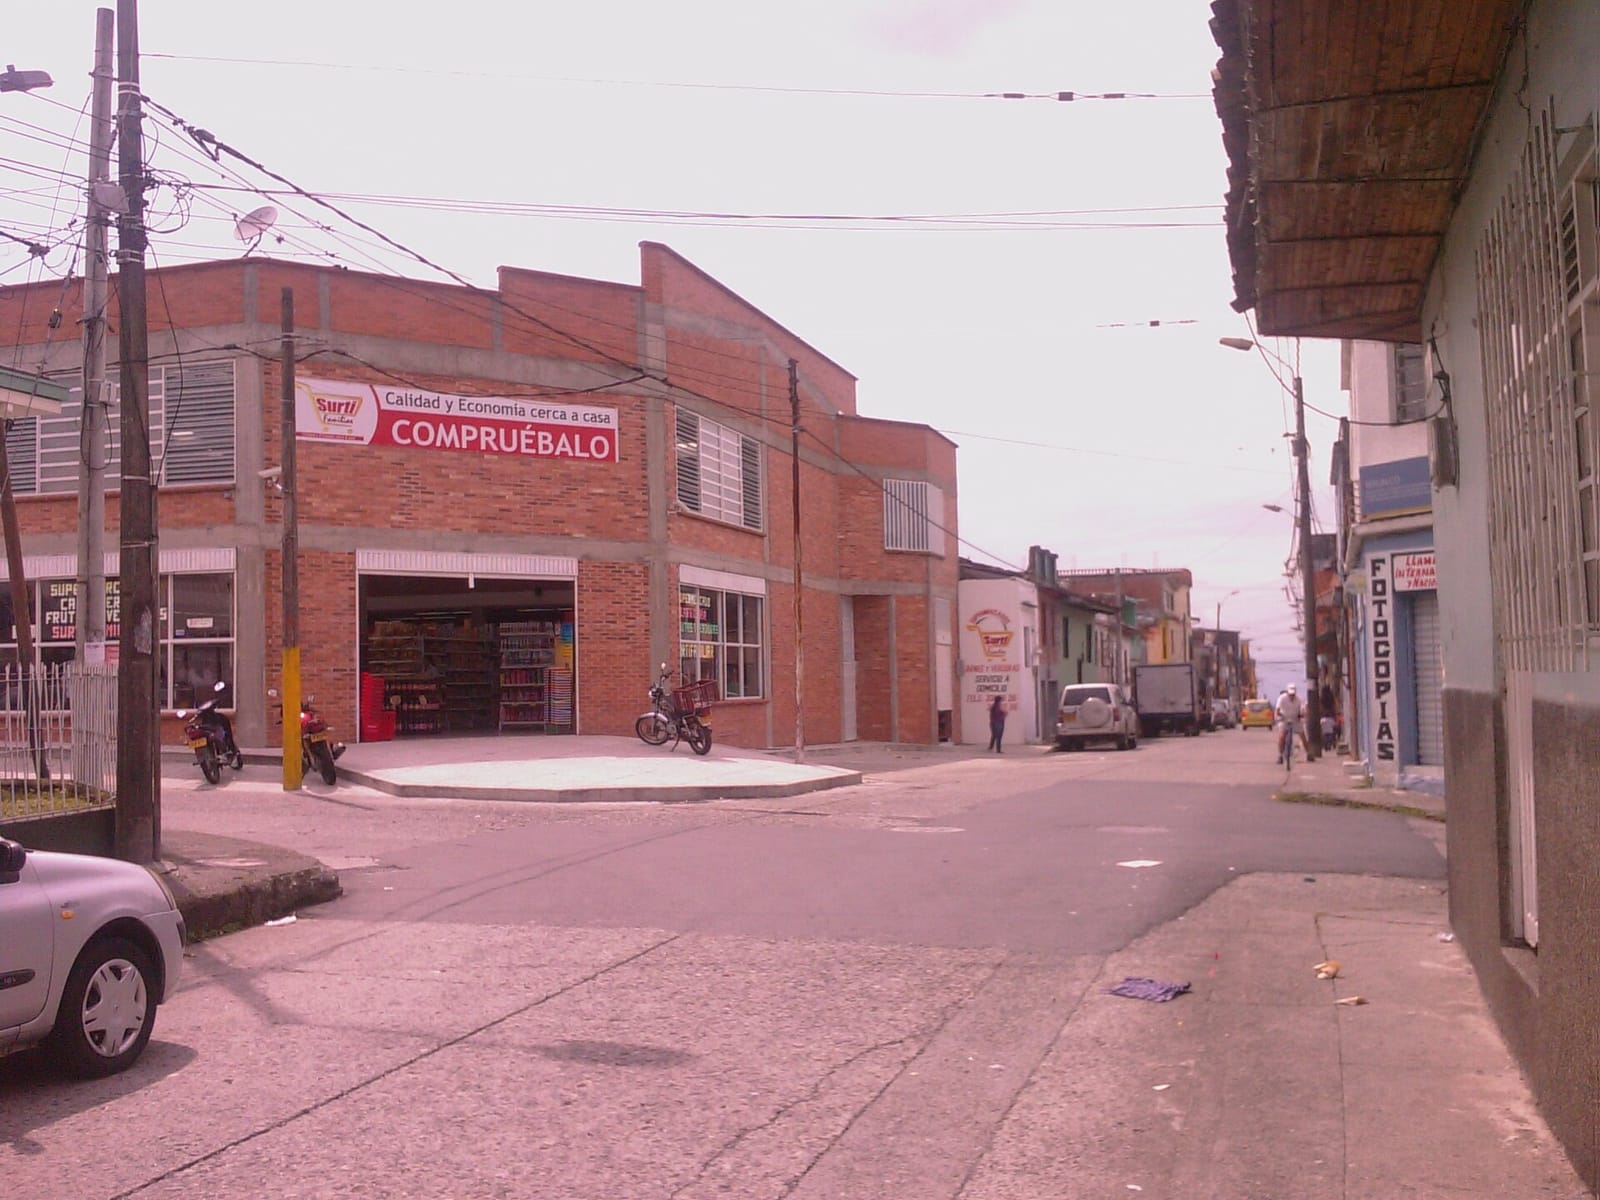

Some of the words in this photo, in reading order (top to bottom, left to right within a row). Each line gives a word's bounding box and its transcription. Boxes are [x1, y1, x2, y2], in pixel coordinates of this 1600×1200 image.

[316, 398, 357, 415] Surti
[385, 391, 440, 410] Calidad
[445, 399, 453, 414] y
[530, 406, 567, 421] cerca
[571, 411, 579, 422] a
[582, 411, 611, 425] casa
[391, 419, 610, 460] COMPRUÉBALO
[1370, 558, 1394, 761] FOTOCOPIAS
